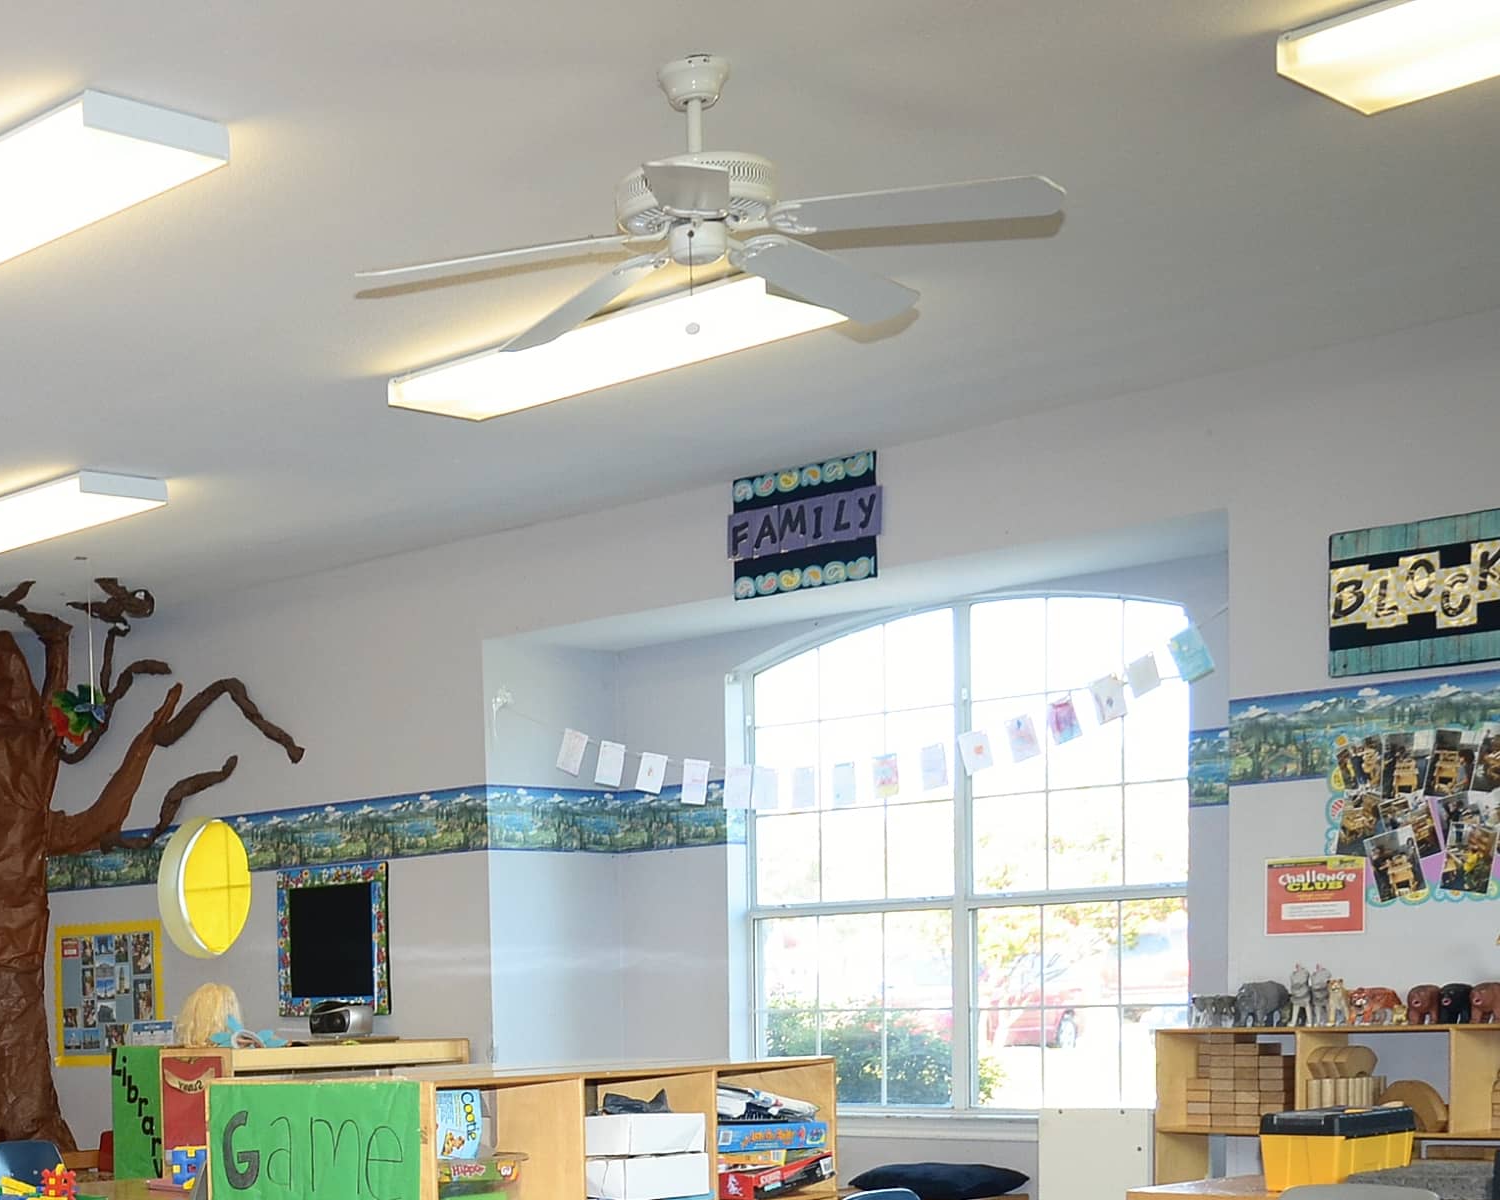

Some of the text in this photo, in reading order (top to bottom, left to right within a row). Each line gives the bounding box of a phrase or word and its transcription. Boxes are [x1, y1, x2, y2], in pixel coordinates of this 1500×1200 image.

[732, 493, 877, 557] FAMILY
[1332, 549, 1500, 620] BLOCK
[1285, 881, 1346, 893] CLUB
